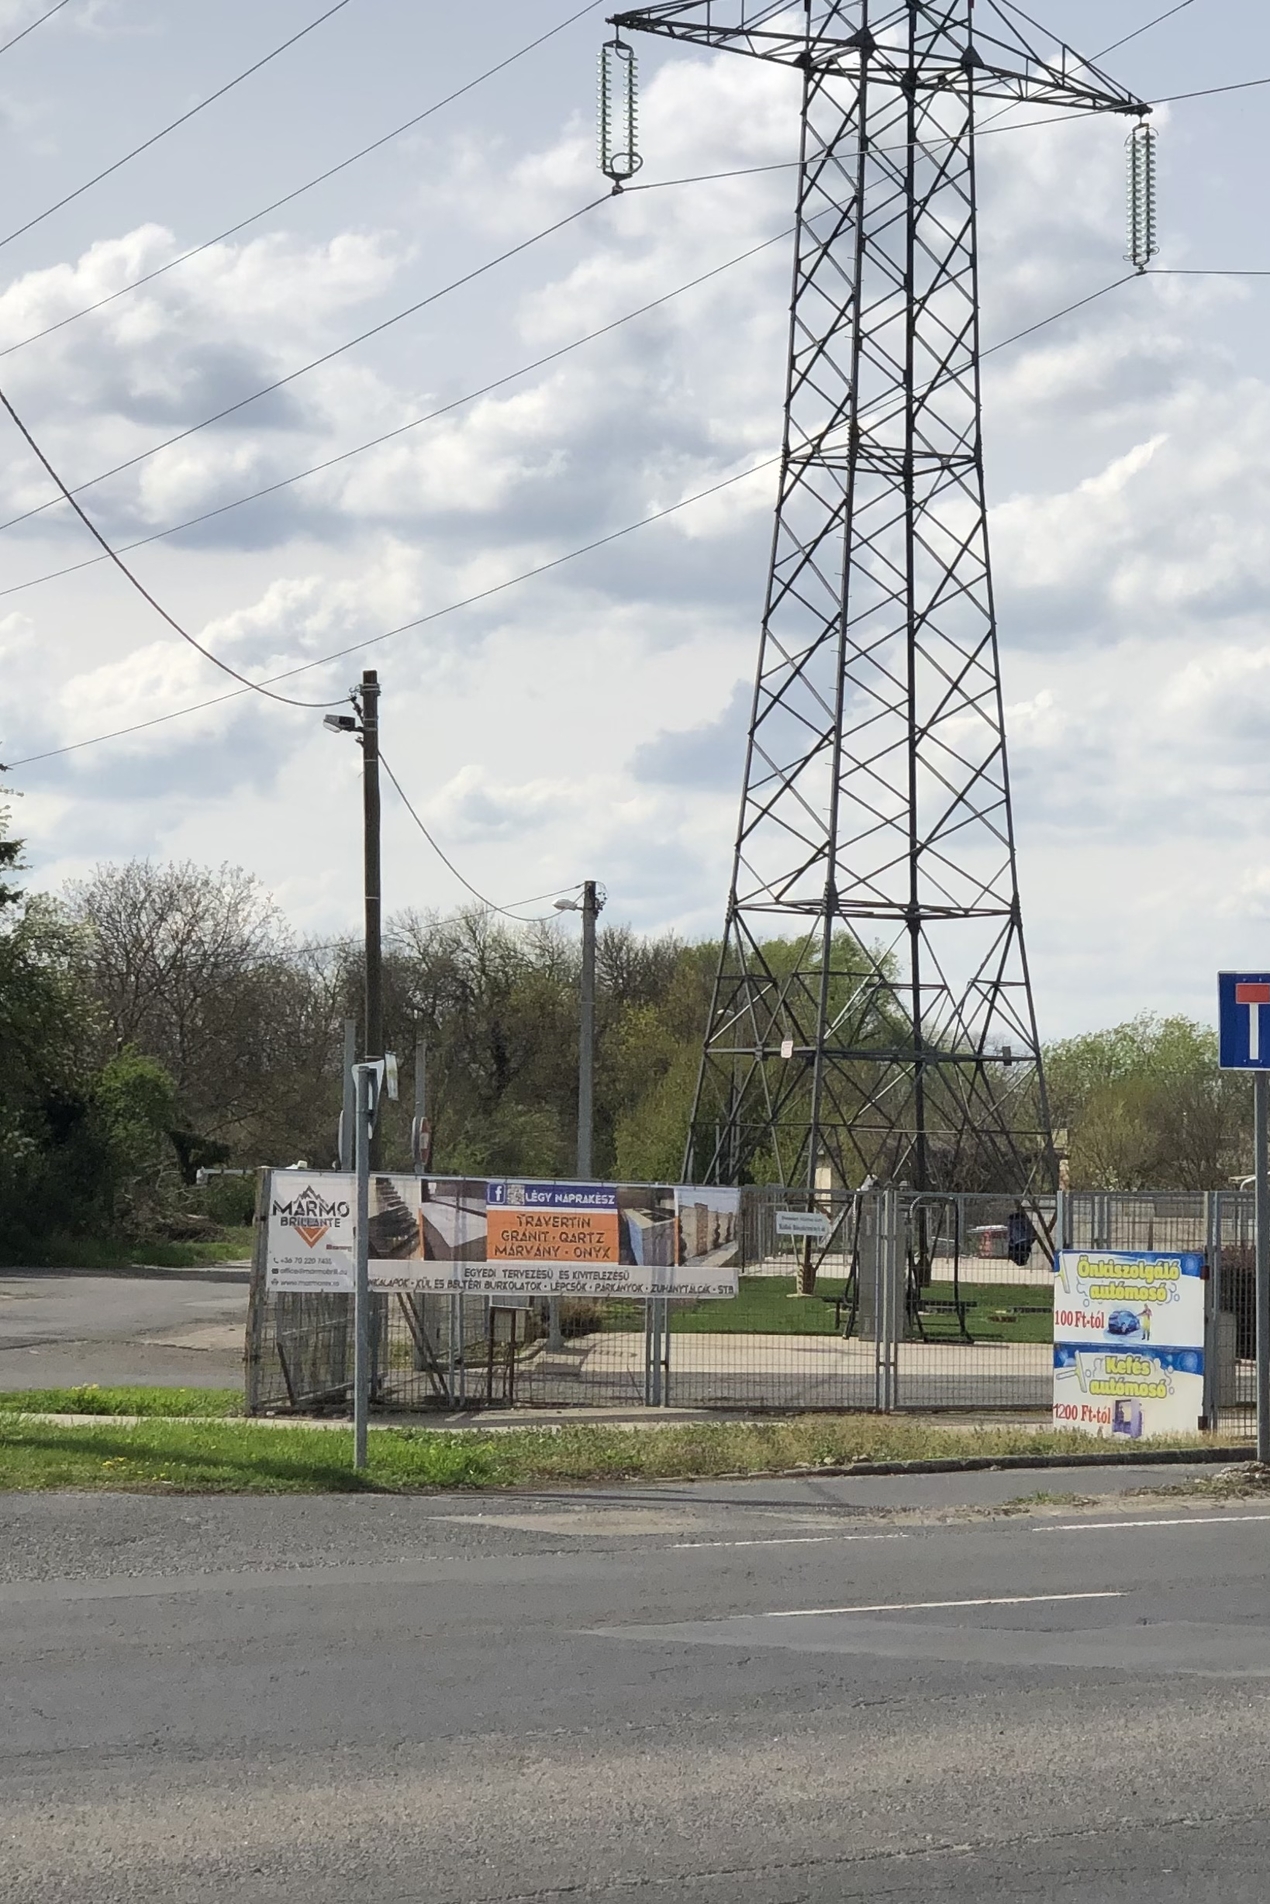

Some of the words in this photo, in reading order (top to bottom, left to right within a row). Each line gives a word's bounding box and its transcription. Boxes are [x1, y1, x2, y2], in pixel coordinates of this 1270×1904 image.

[525, 1190, 552, 1202] LÉGY
[555, 1192, 615, 1205] NAPRAKÉSZ
[272, 1200, 350, 1217] MARMO
[280, 1217, 341, 1227] BRILLANTE
[517, 1214, 591, 1228] TRAVERTIN
[501, 1228, 549, 1242] GRÁNIT
[559, 1232, 605, 1243] QARTZ
[494, 1243, 561, 1258] MÁRVÁNY
[573, 1246, 611, 1259] ONYX
[464, 1268, 496, 1278] EGYEDI
[1077, 1255, 1180, 1284] Önkiszolgáló
[484, 1280, 542, 1291] BURKOLATOK
[1089, 1281, 1168, 1302] autómosó
[1055, 1310, 1073, 1327] 100
[1075, 1311, 1104, 1329] Ft-tól
[1105, 1355, 1151, 1376] Kefés
[1089, 1377, 1168, 1398] autómosó
[1053, 1403, 1078, 1420] 1200
[1081, 1405, 1111, 1424] Ft-tól
